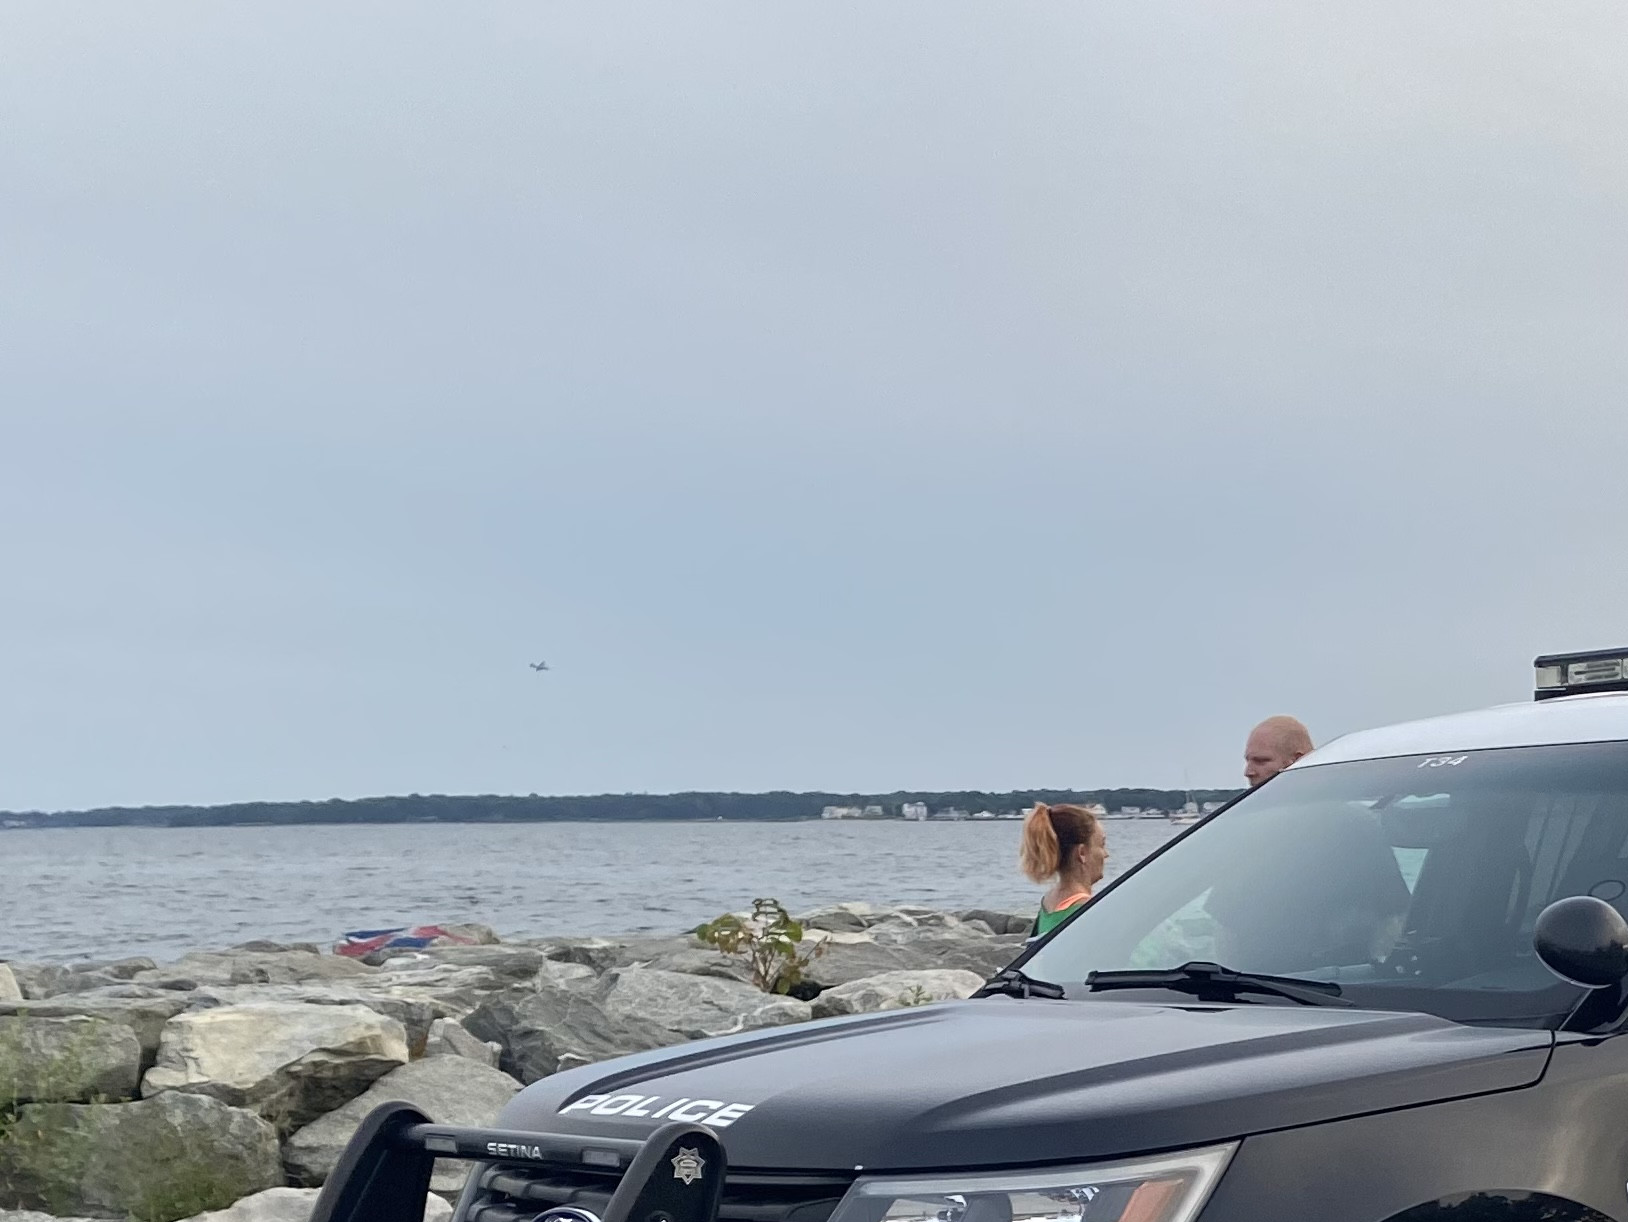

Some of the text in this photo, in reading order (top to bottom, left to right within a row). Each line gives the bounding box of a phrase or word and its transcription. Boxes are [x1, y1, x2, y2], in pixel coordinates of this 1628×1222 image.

[1417, 755, 1468, 768] T34
[557, 1094, 755, 1127] POLICE
[487, 1142, 543, 1160] SETINA
